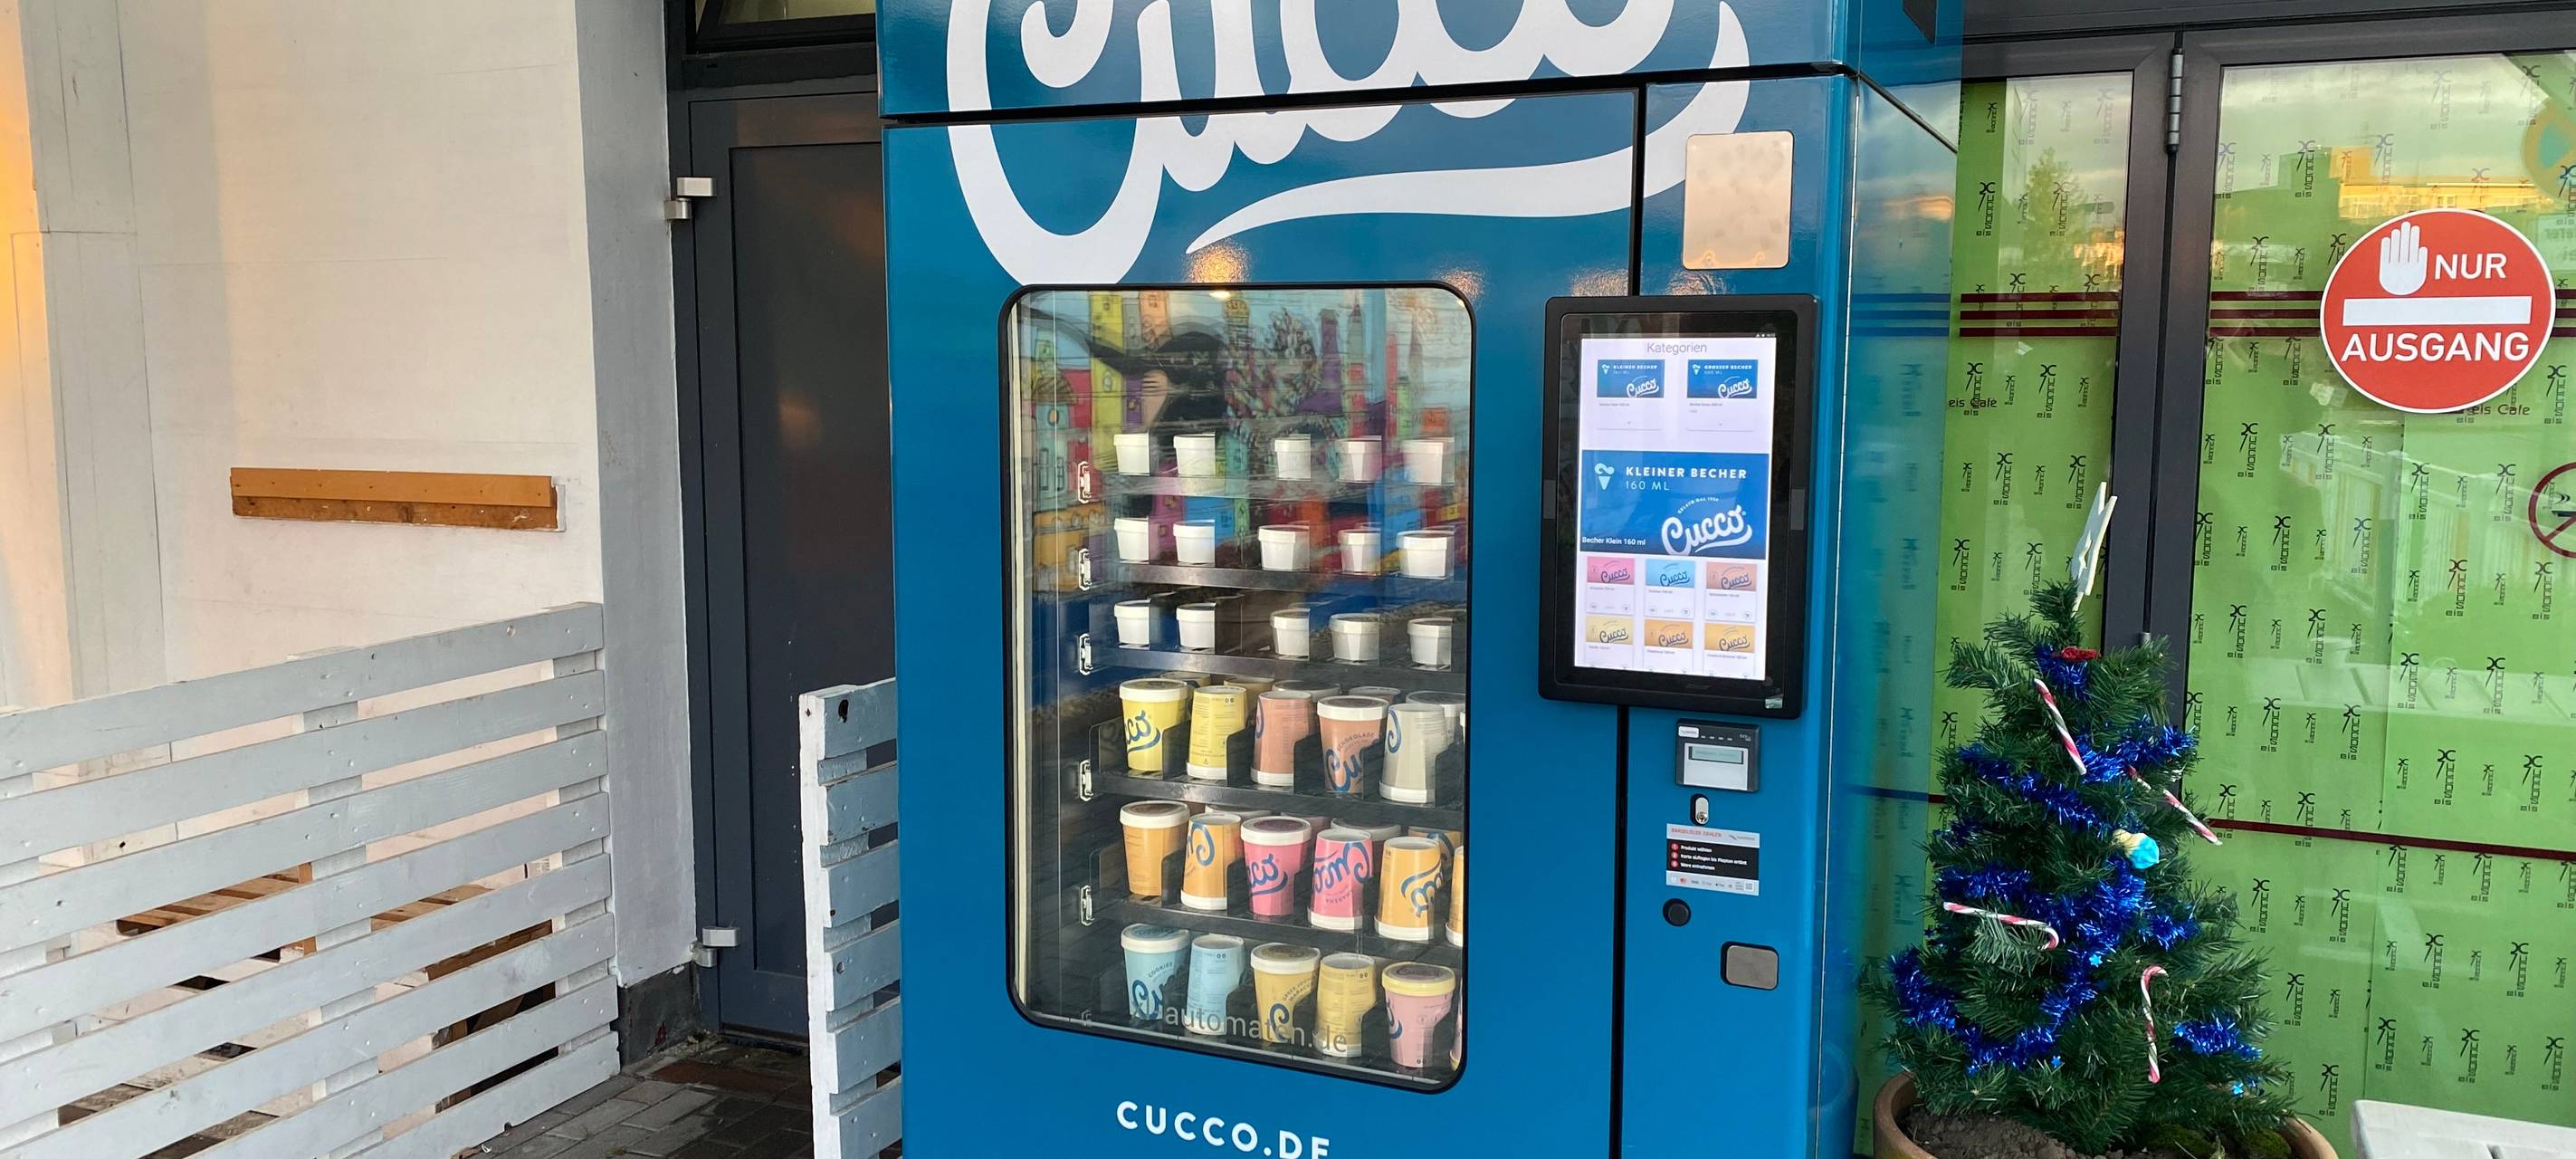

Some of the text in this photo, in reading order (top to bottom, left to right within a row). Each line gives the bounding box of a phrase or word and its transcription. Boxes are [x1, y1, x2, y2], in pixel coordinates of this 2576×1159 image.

[2435, 253, 2507, 280] NUR
[1646, 342, 1706, 355] Kategorien
[2341, 331, 2529, 361] AUSGANG
[1949, 398, 1965, 407] eis
[1626, 466, 1747, 479] KLEINER BECHER
[1626, 480, 1669, 491] 160 ML
[1662, 504, 1752, 556] Cucco
[1116, 1101, 1330, 1159] CUCCO.DE
